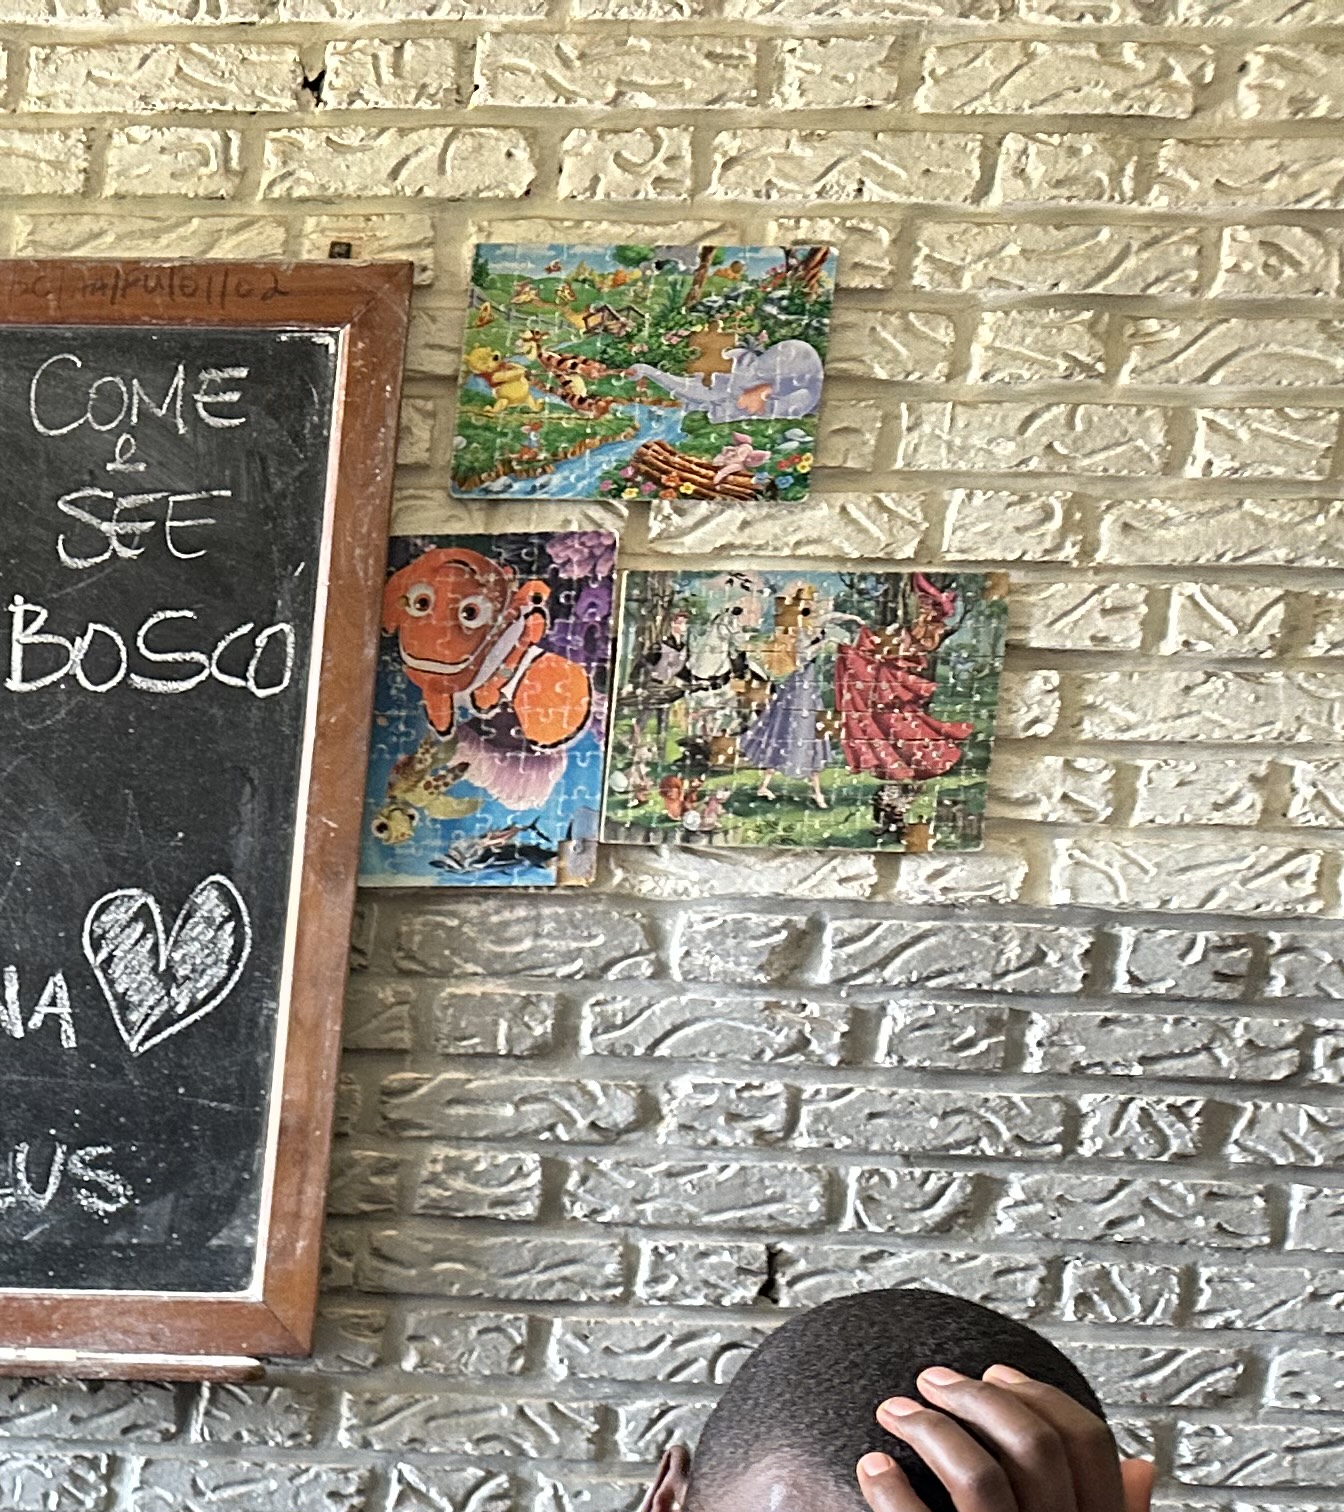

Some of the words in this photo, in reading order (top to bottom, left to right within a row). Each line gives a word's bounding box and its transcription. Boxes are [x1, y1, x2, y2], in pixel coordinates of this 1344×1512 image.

[29, 353, 250, 436] COME
[57, 487, 232, 569] SEE
[4, 595, 296, 698] BOSCO
